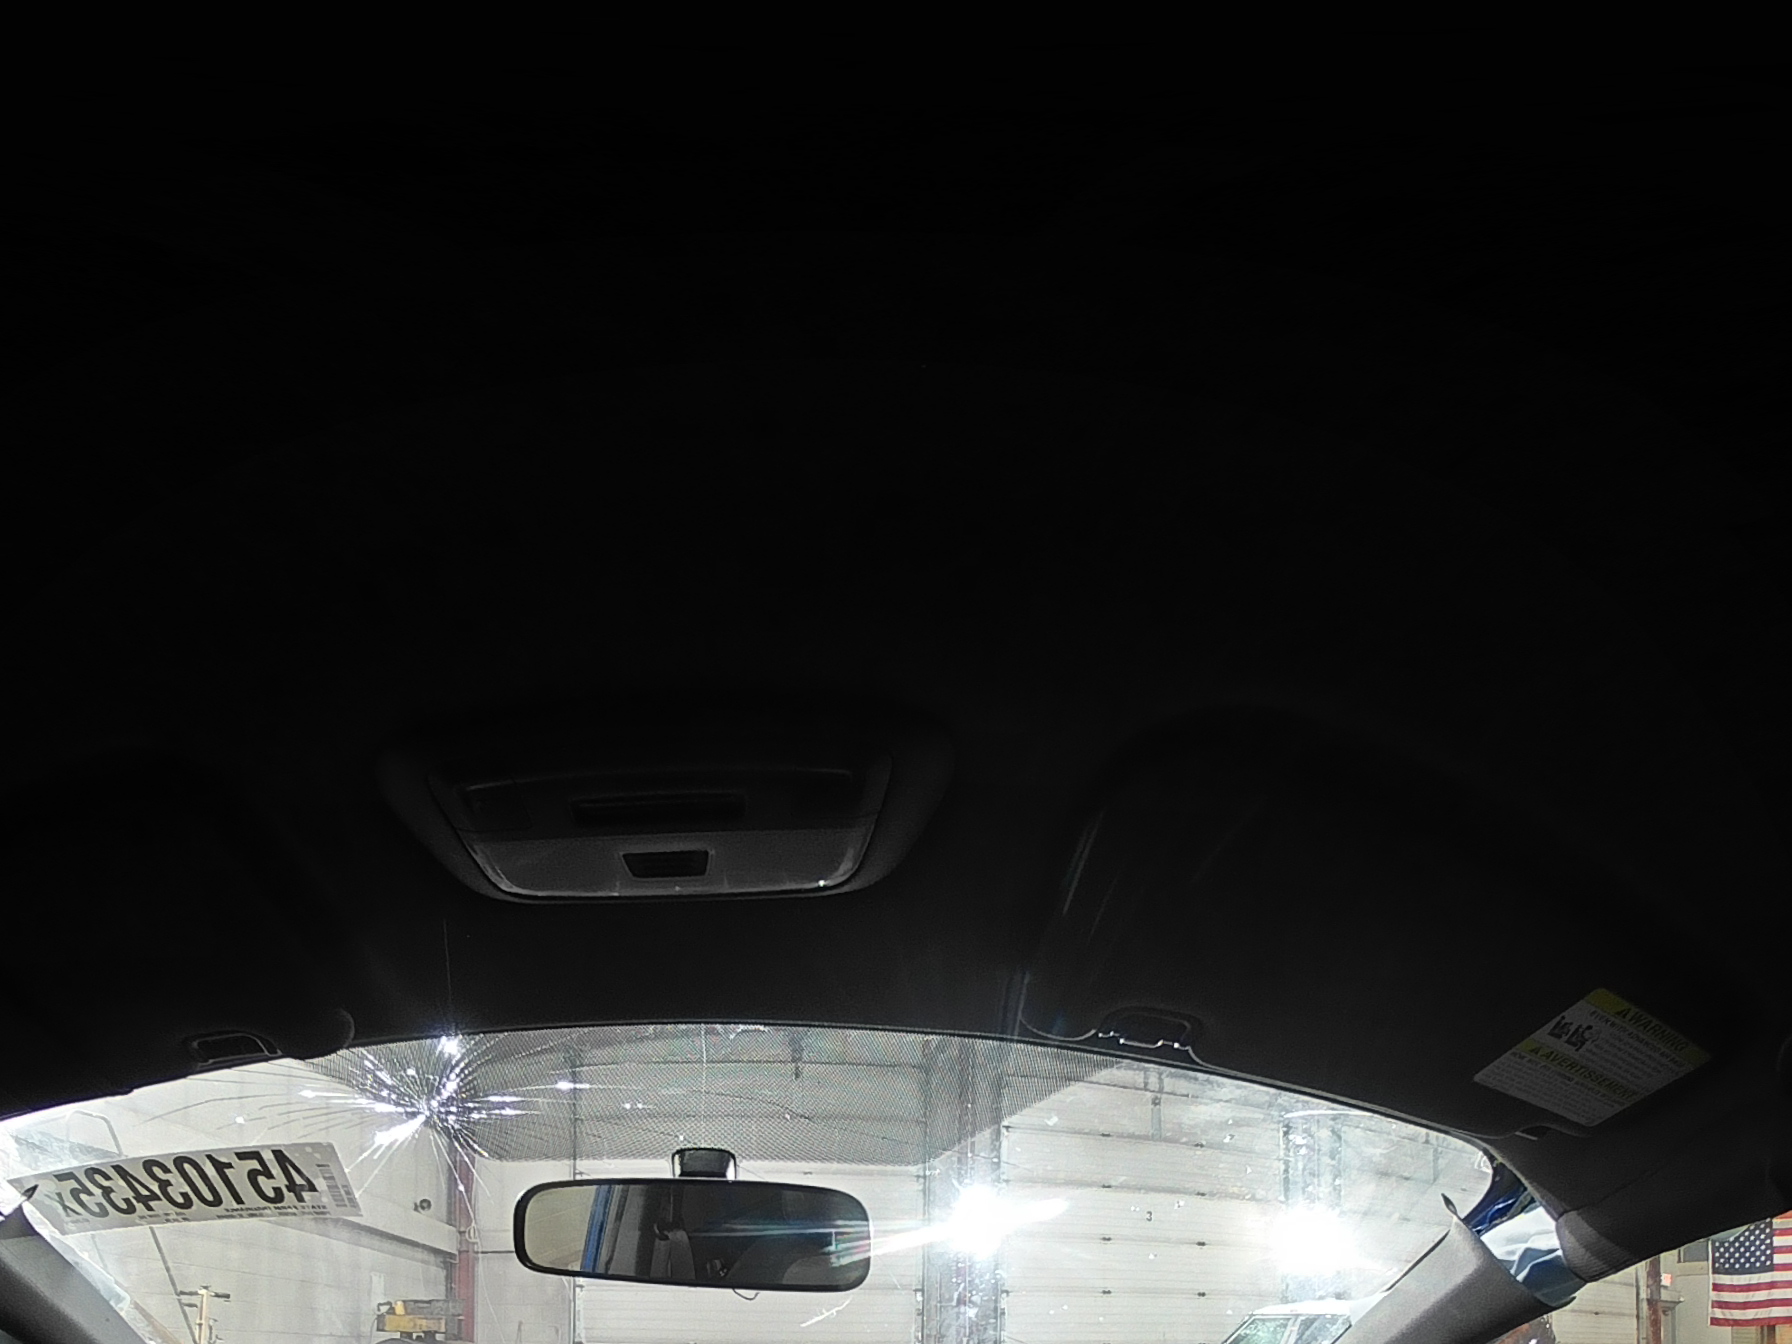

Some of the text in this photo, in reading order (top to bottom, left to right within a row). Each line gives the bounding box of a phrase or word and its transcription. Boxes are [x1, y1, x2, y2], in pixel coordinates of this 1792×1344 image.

[1627, 1010, 1688, 1053] WARNING
[1539, 1050, 1638, 1099] AVERTISSEMENT
[1146, 1211, 1153, 1222] 3
